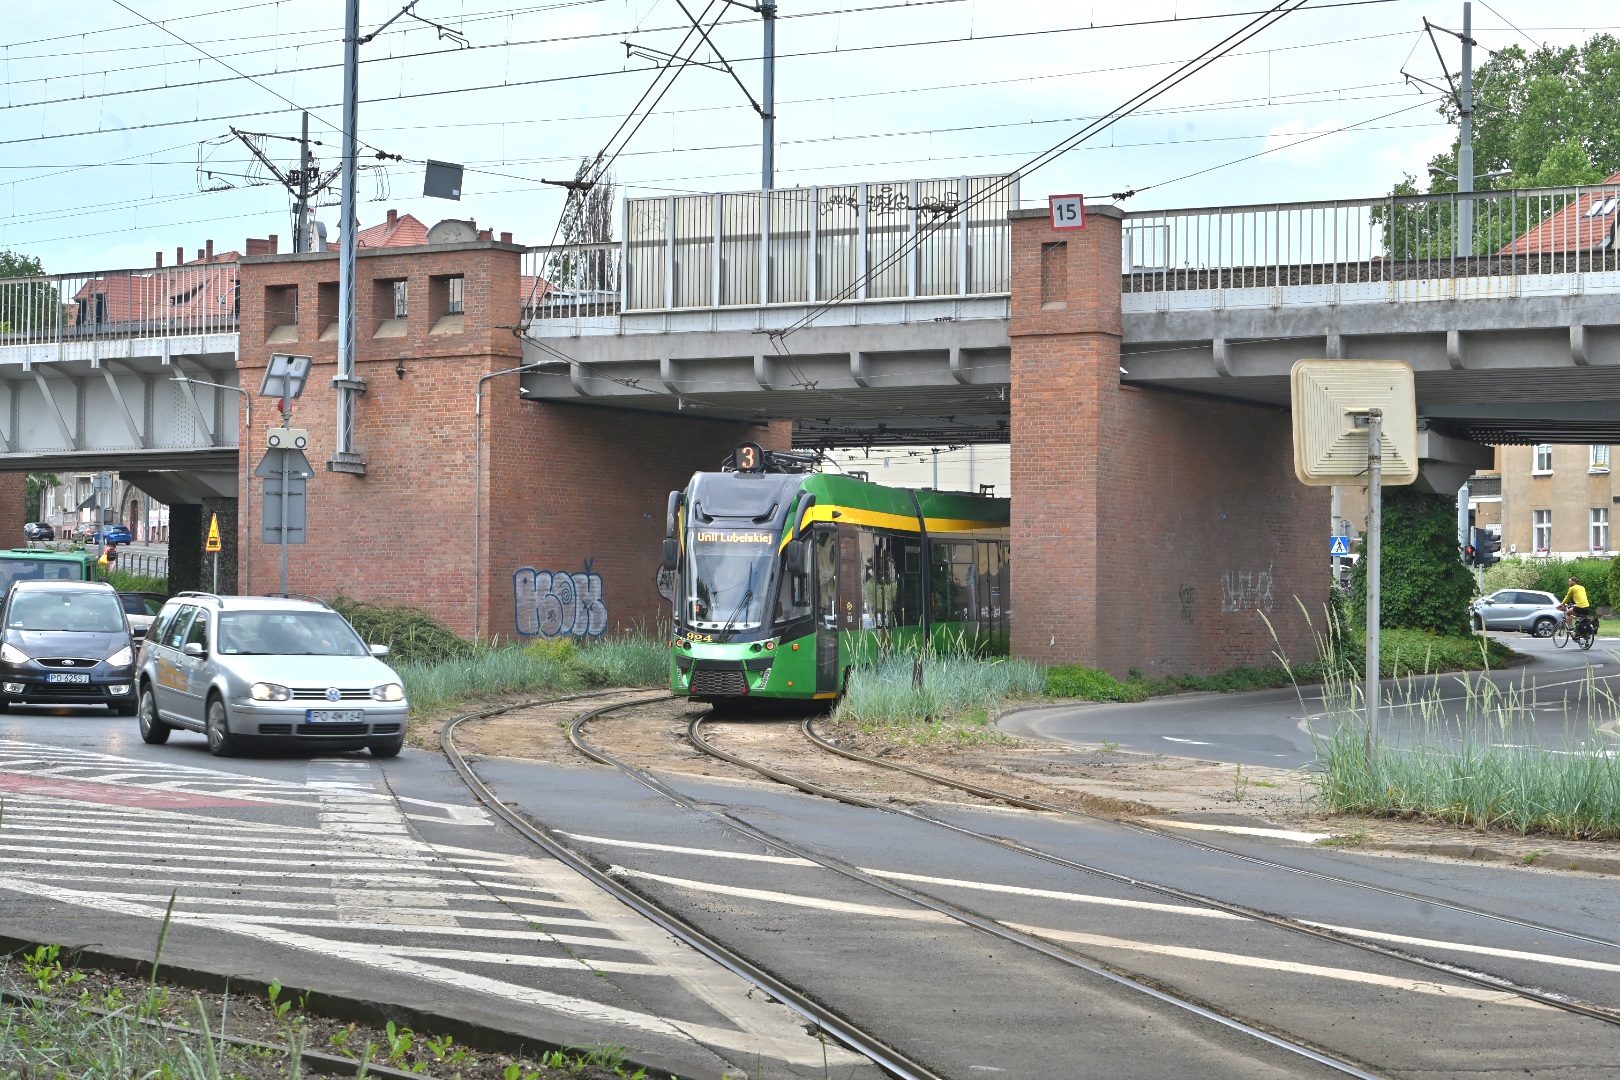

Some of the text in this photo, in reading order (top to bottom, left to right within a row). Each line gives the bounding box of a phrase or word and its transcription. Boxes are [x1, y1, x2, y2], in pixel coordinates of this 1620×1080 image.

[1056, 203, 1077, 221] 15
[741, 446, 754, 469] 3
[720, 533, 773, 545] Lubelskiej
[686, 631, 713, 643] 924
[50, 674, 62, 682] PO
